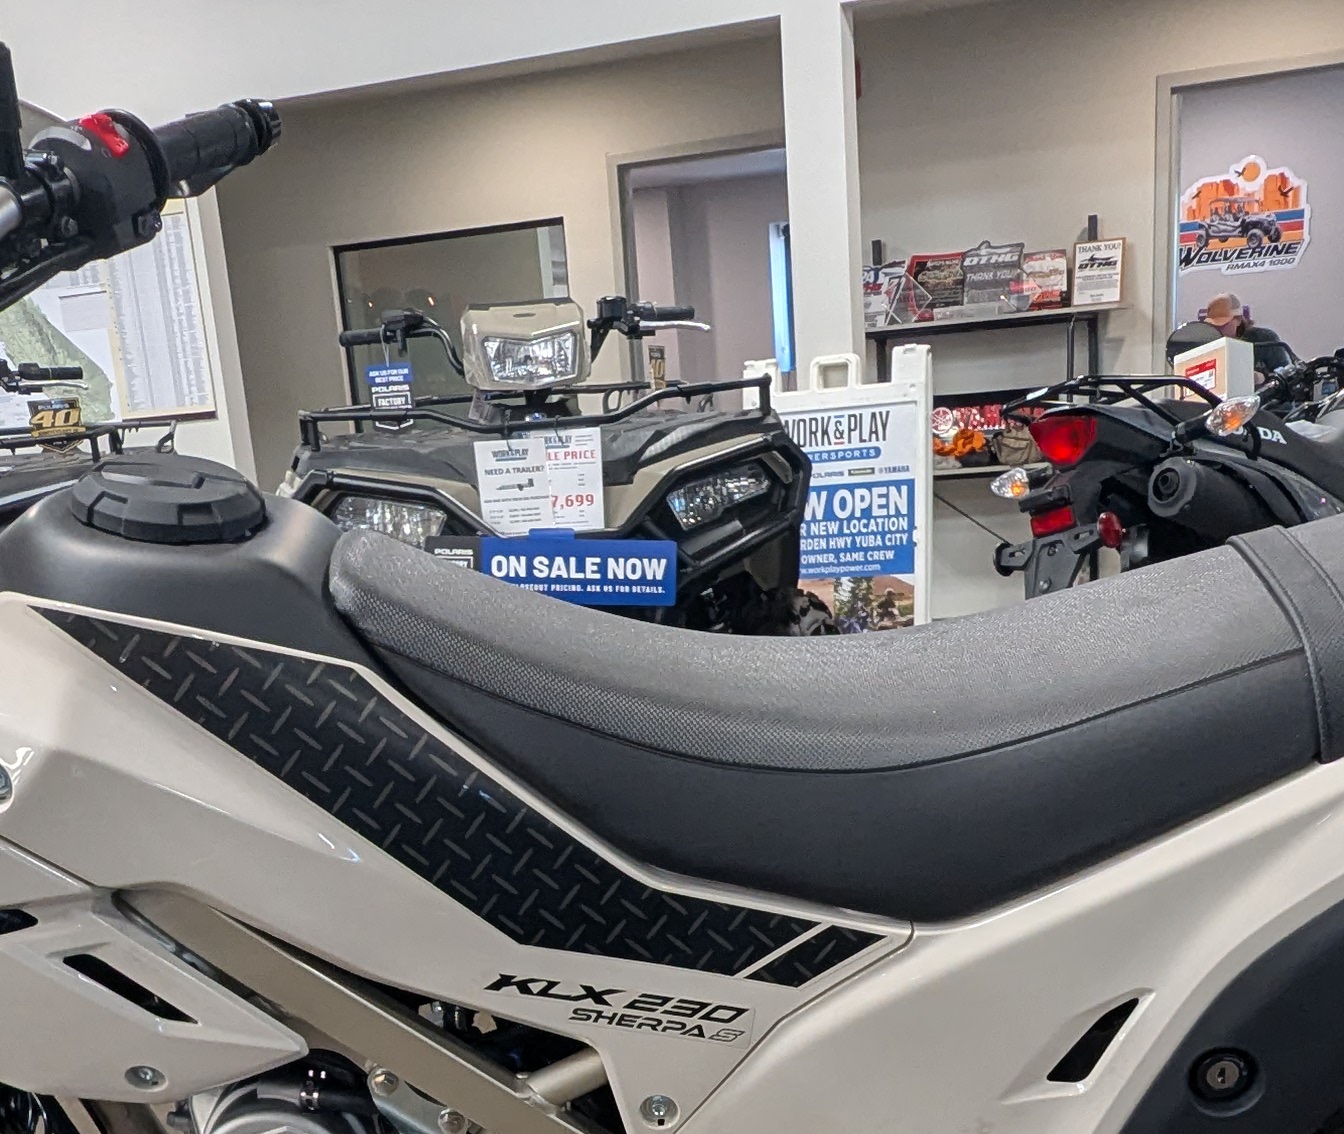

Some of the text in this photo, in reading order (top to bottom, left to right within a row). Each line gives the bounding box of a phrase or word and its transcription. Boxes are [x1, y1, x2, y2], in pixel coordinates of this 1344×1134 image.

[1077, 245, 1103, 255] THANK
[1179, 241, 1301, 268] WOLVERINE
[966, 272, 994, 282] THANK
[371, 384, 410, 393] POLARIS
[377, 397, 406, 406] FACTORY
[30, 408, 80, 428] 40
[563, 449, 596, 460] PRICE
[810, 448, 877, 461] ERSPORTS
[484, 467, 504, 476] NEED
[512, 465, 545, 474] TRAILER?
[812, 470, 845, 479] OLARIS
[832, 485, 908, 519] OPEN
[810, 521, 840, 536] NEW
[843, 516, 908, 534] LOCATION
[800, 533, 909, 550] RDEN HWY YUBA CITY
[434, 548, 474, 556] POLARIS
[801, 550, 895, 565] OWNER, SAME CREW
[491, 555, 667, 581] ON SALE NOW
[800, 564, 881, 575] w.workplaypower.com
[586, 584, 601, 593] ASK
[602, 585, 613, 593] US
[615, 585, 630, 593] FOR
[631, 585, 666, 594] DETAILS.
[483, 973, 749, 1023] KLX 230
[568, 1008, 706, 1039] SHERPA
